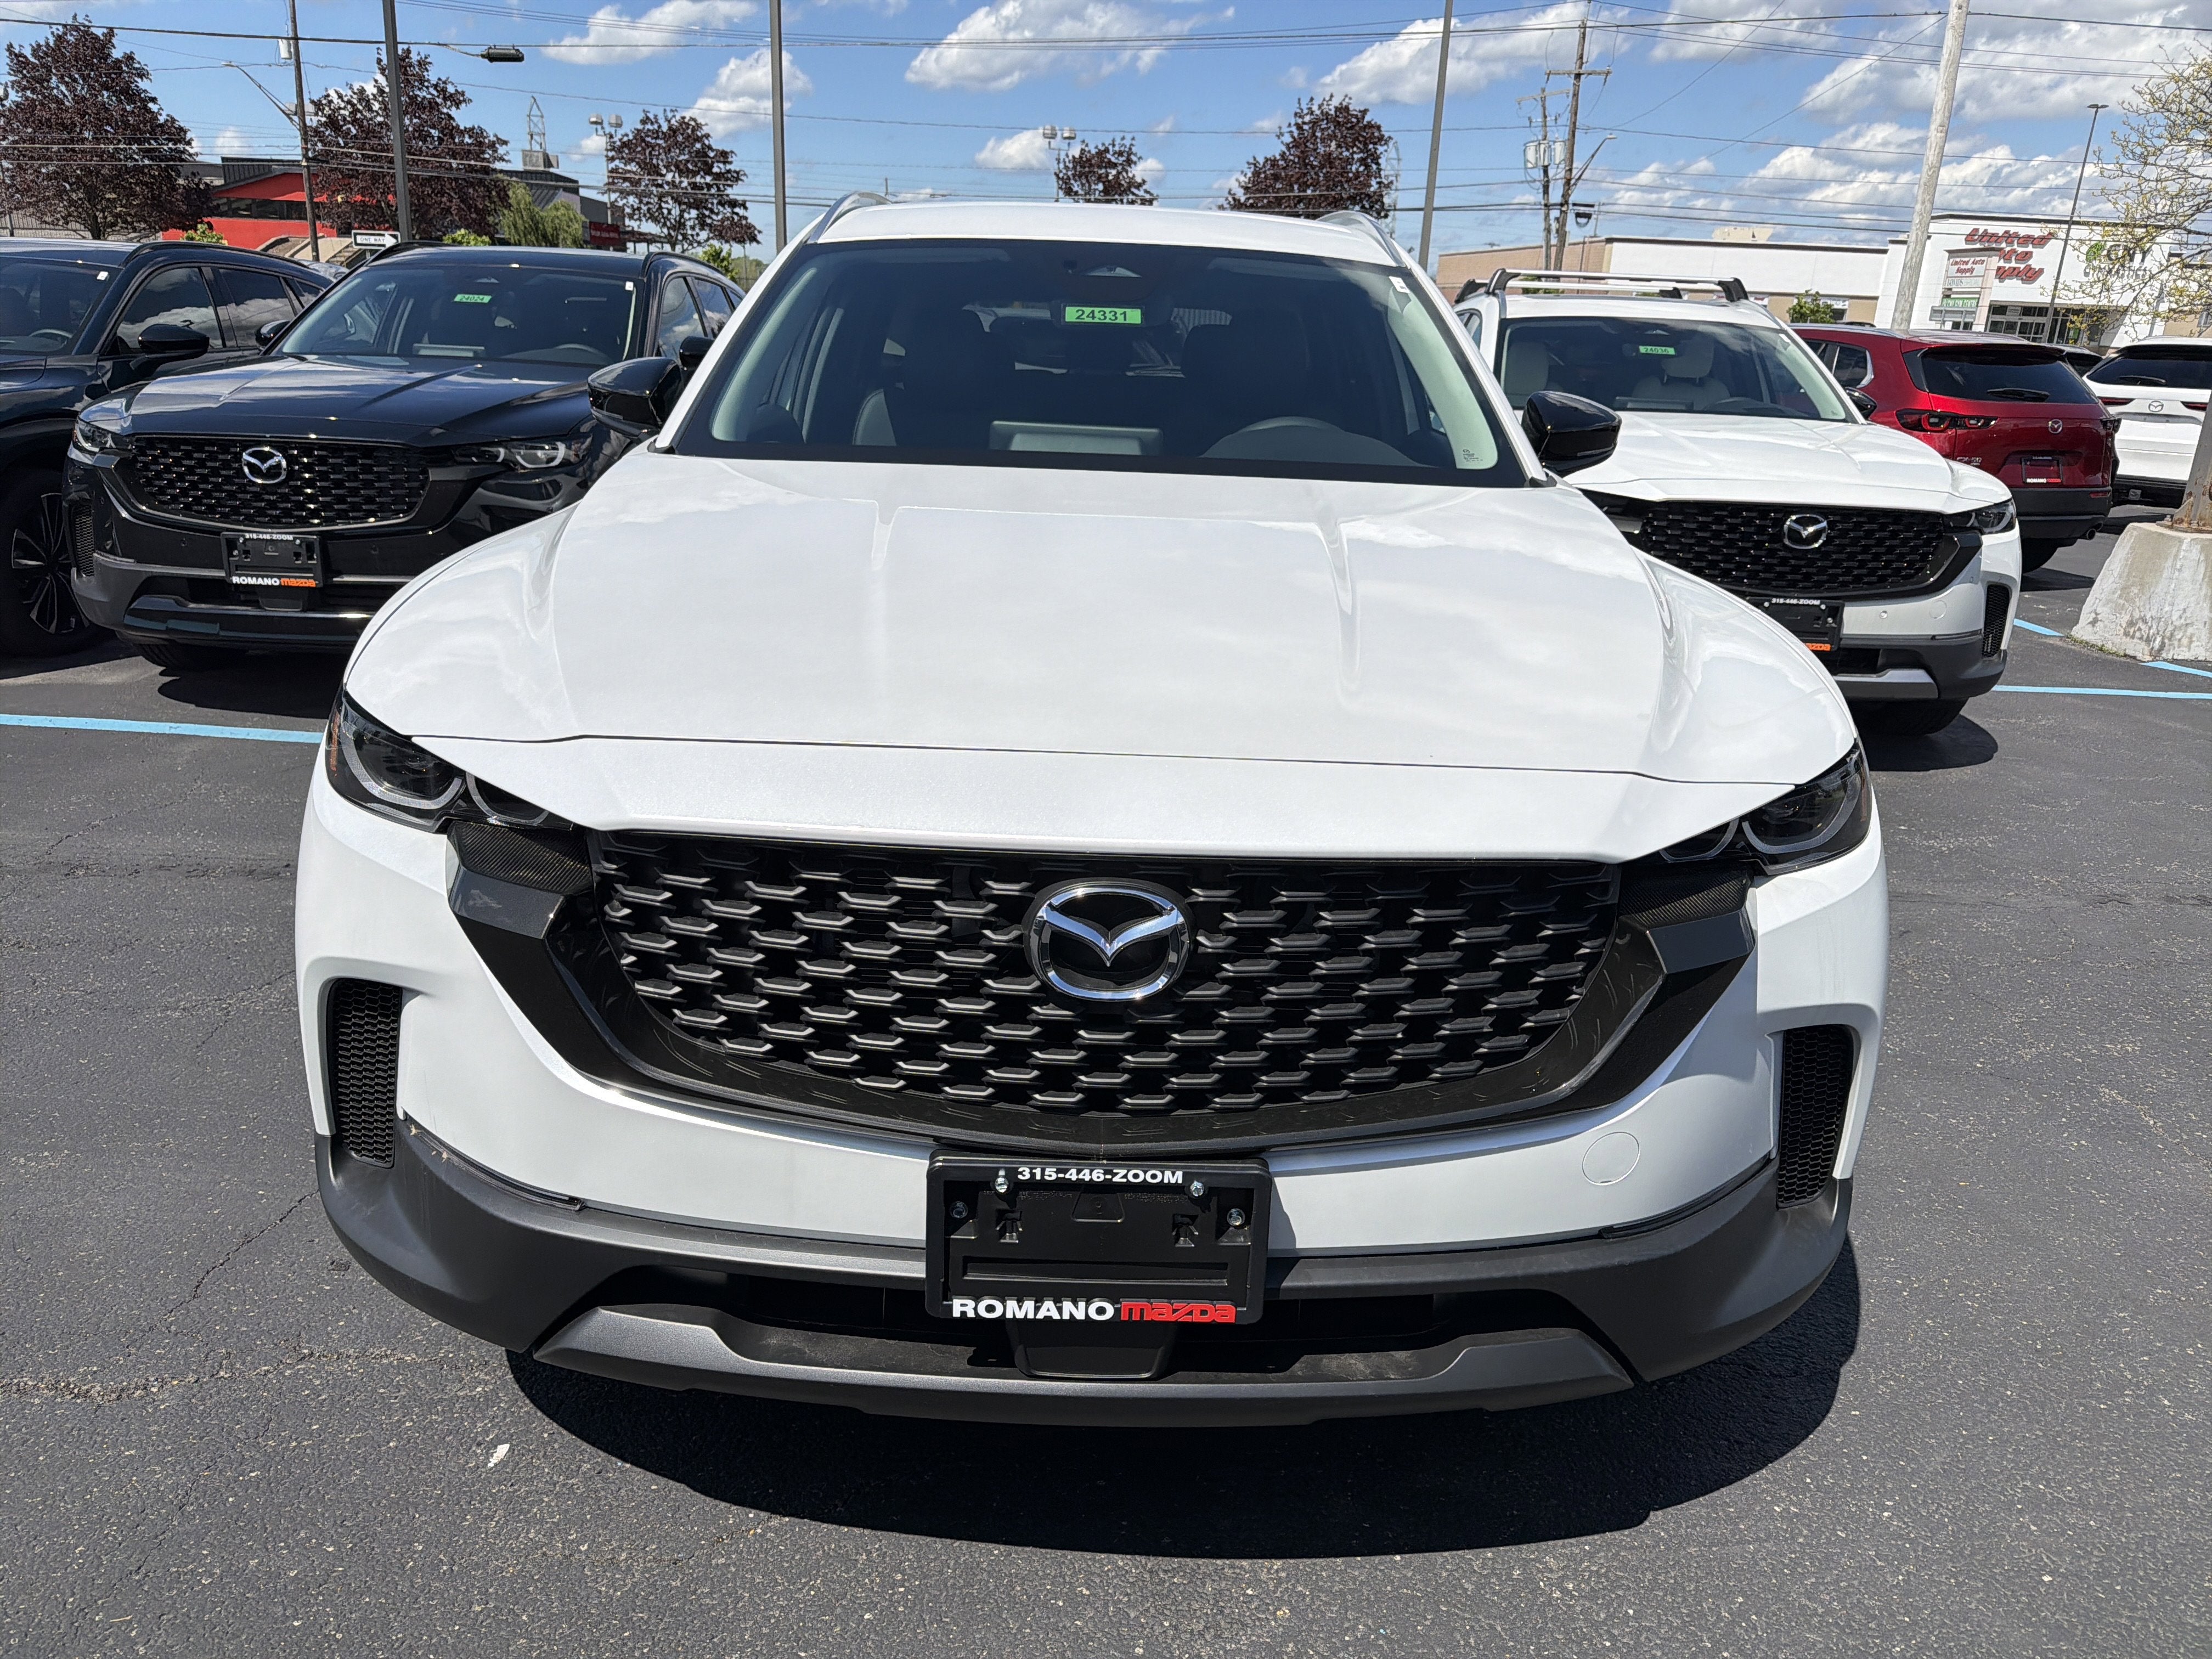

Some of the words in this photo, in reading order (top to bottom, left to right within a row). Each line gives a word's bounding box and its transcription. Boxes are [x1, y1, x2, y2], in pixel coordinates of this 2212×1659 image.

[1965, 228, 2053, 246] United
[1998, 249, 2033, 264] to
[1955, 266, 1975, 275] Supply
[1994, 264, 2045, 284] pply
[1075, 309, 1127, 321] 24331
[232, 576, 280, 586] ROMANO
[1017, 1167, 1183, 1184] 315-446-ZOOM
[952, 1299, 1115, 1321] ROMANO
